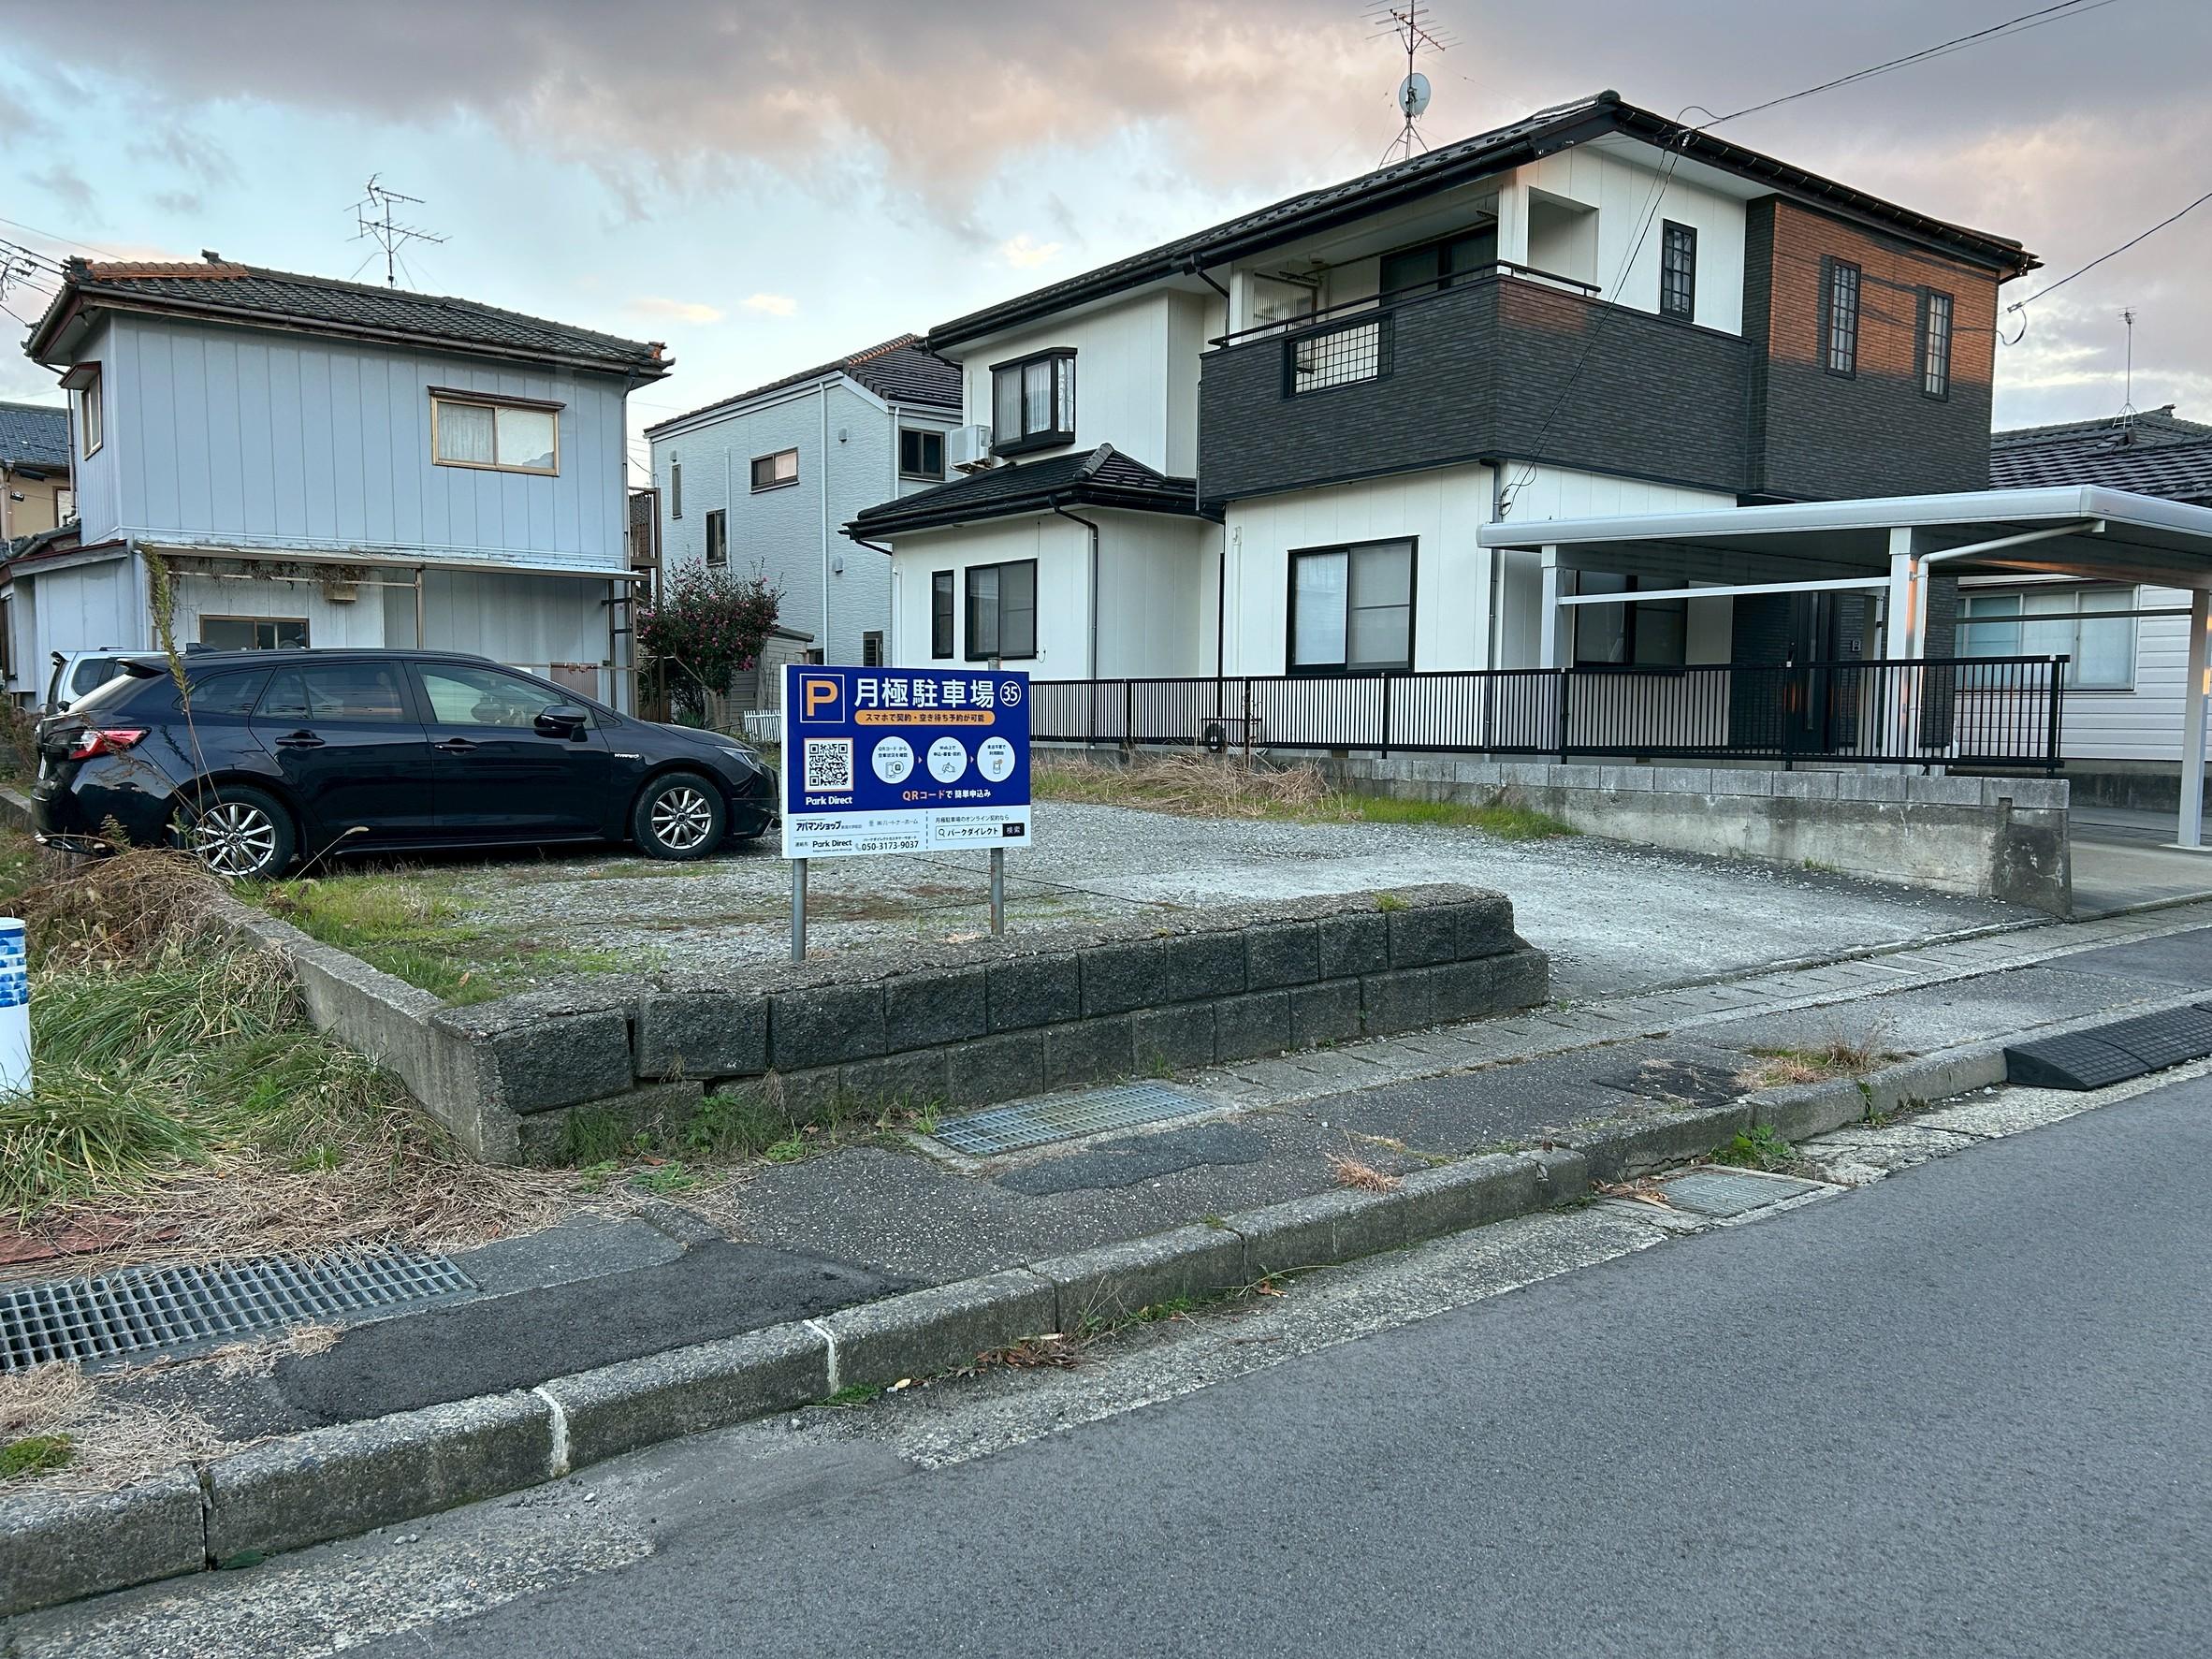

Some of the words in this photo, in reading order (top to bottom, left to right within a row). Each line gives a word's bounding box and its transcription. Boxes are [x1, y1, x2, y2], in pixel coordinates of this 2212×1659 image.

[854, 677, 995, 708] 月極駐車場
[807, 680, 838, 717] P
[865, 713, 985, 723] スマホで契約・空き待ち予約が可能
[806, 795, 827, 806] Park
[828, 795, 852, 805] Direct
[795, 821, 842, 832] アパマンショップ
[947, 827, 998, 837] パークダイレクト
[1006, 825, 1021, 835] 検索
[861, 840, 919, 851] 050-3173-9037
